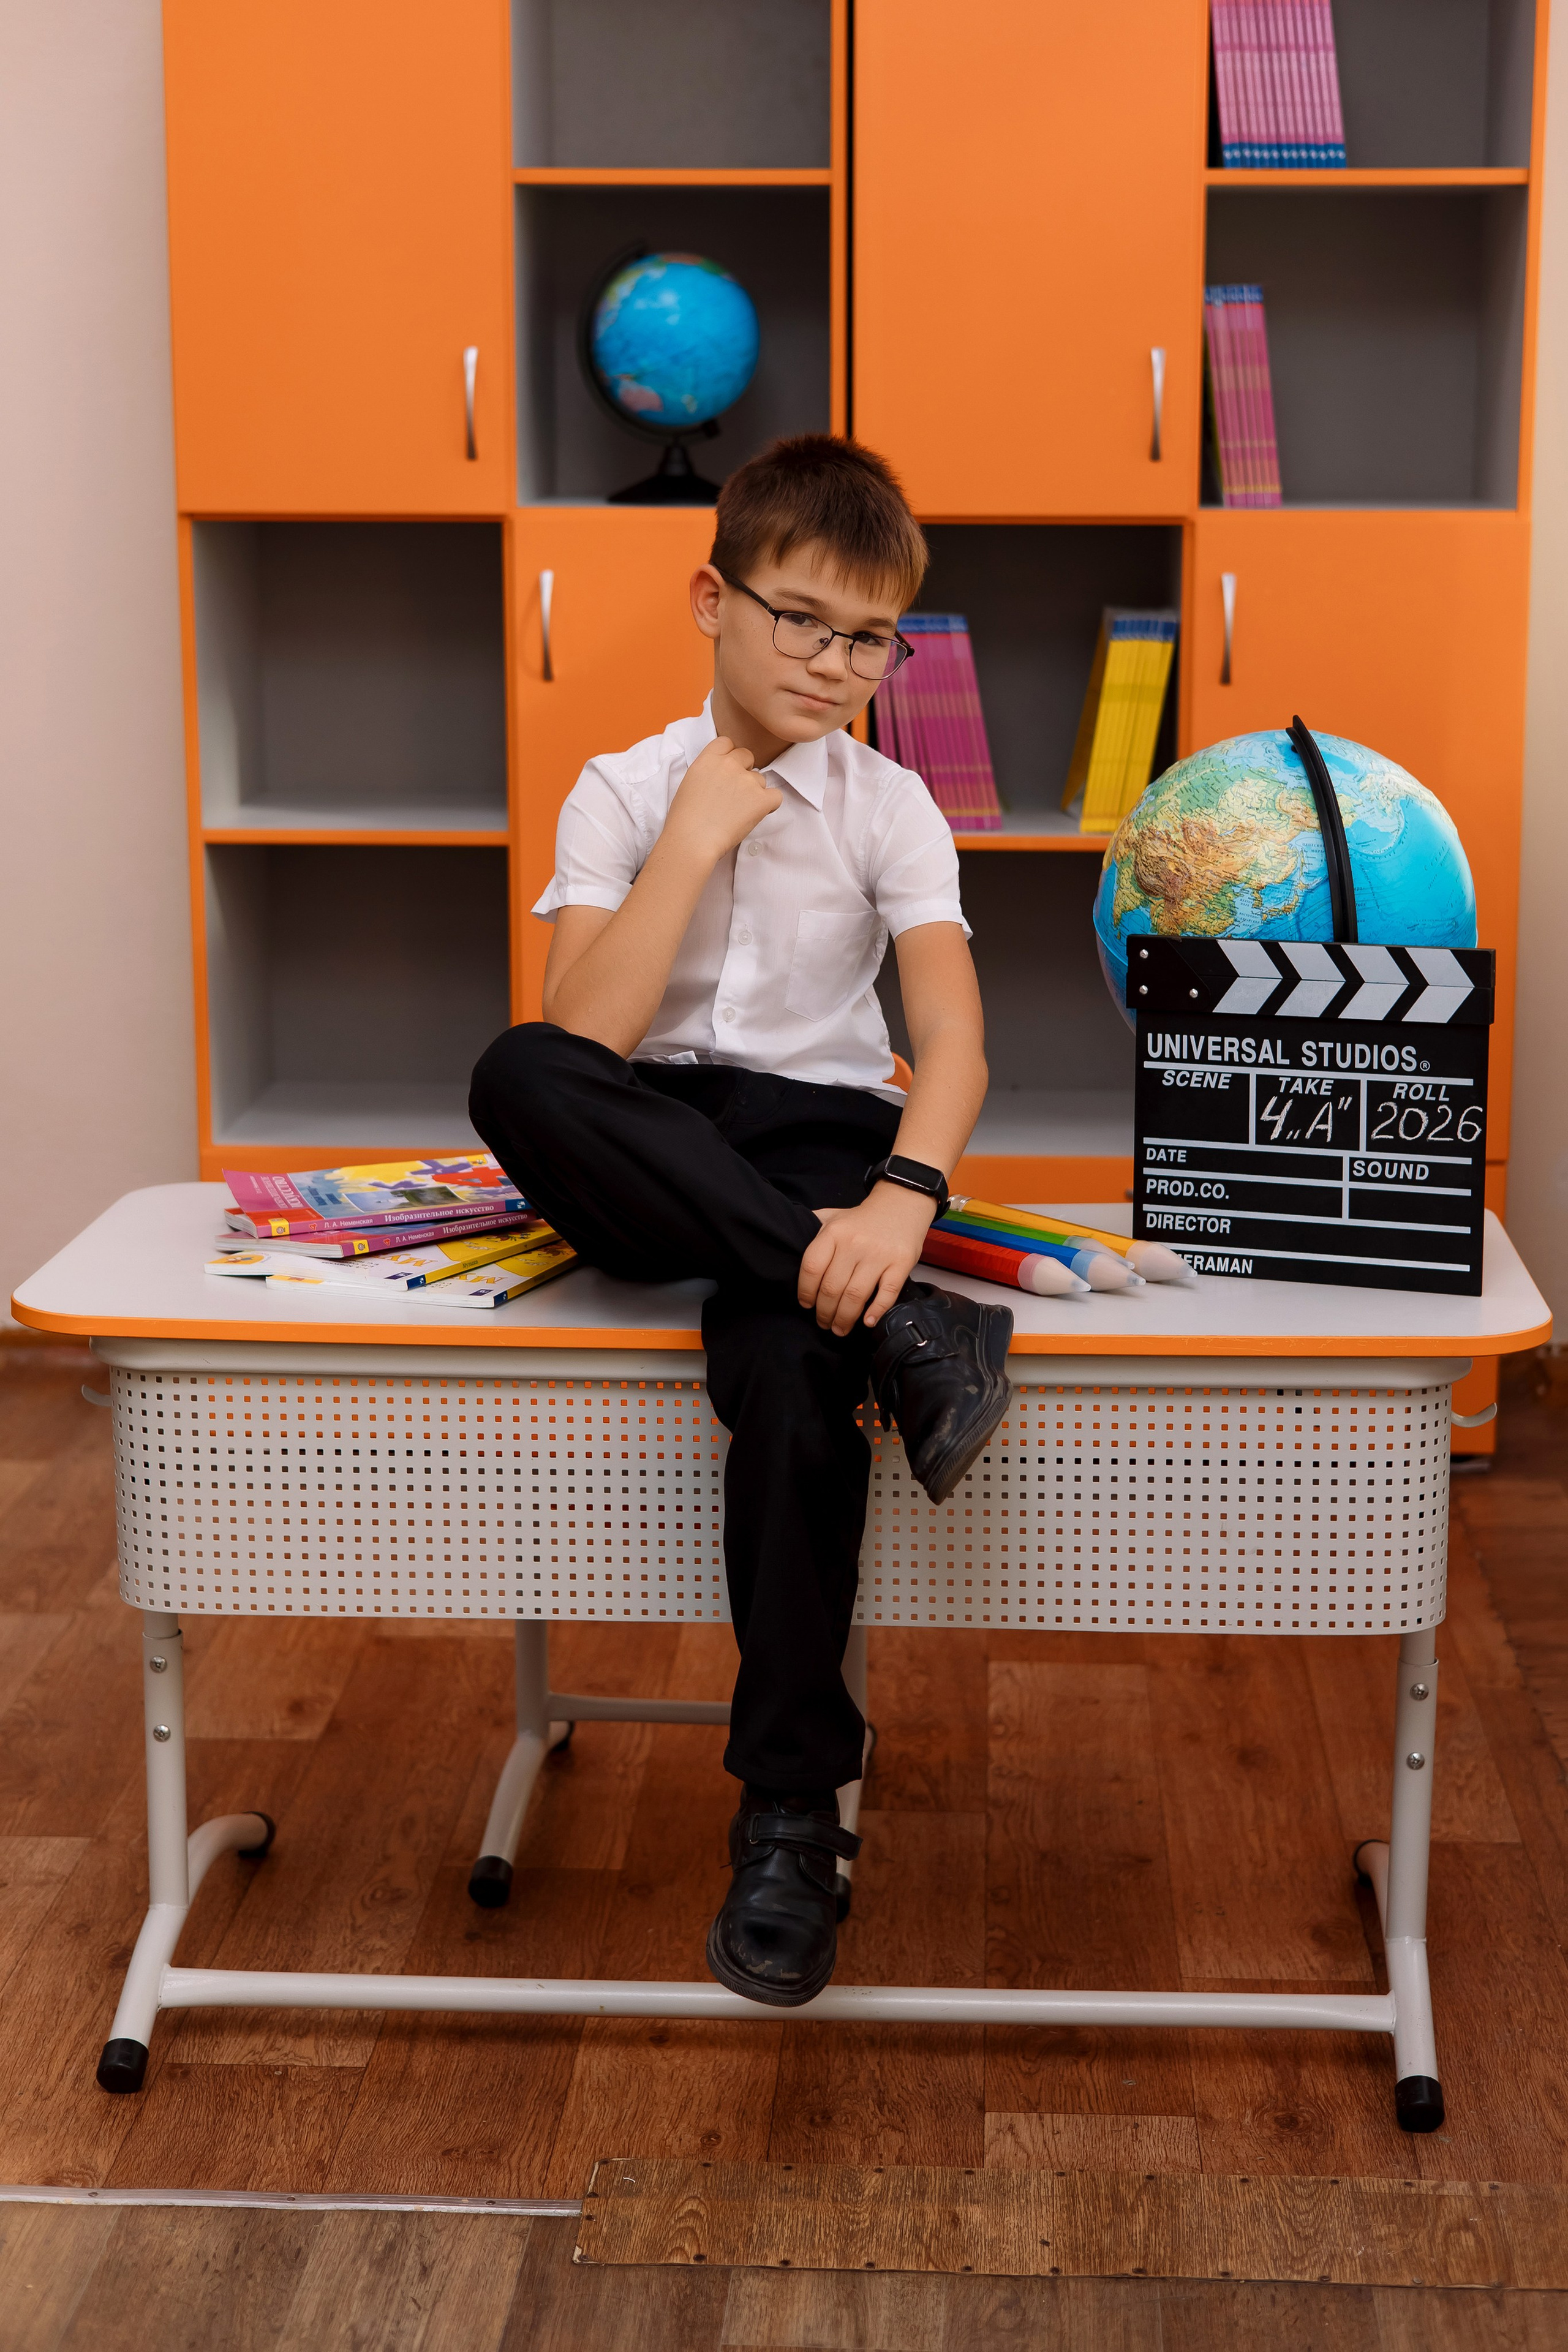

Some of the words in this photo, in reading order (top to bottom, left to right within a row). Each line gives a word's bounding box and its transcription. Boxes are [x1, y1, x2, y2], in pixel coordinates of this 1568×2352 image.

[1147, 1033, 1290, 1065] UNIVERSAL
[1162, 1069, 1232, 1089] SCENE
[1278, 1077, 1334, 1096] TAKE
[1392, 1083, 1450, 1102] ROLL
[1371, 1101, 1483, 1143] 2026
[1146, 1147, 1187, 1163] DATE
[1352, 1160, 1430, 1181] SOUND
[1146, 1178, 1229, 1199] PROD.CO.
[325, 1219, 331, 1229] Л.
[332, 1219, 339, 1227] А.
[340, 1218, 374, 1227] Неменская
[385, 1208, 454, 1223] Изобразительное
[455, 1204, 494, 1215] искусство
[408, 1231, 435, 1240] Неменская
[443, 1218, 497, 1234] Изобразительное
[498, 1213, 528, 1224] искусство
[1146, 1213, 1231, 1234] DIRECTOR
[1177, 1254, 1253, 1274] ERAMAN
